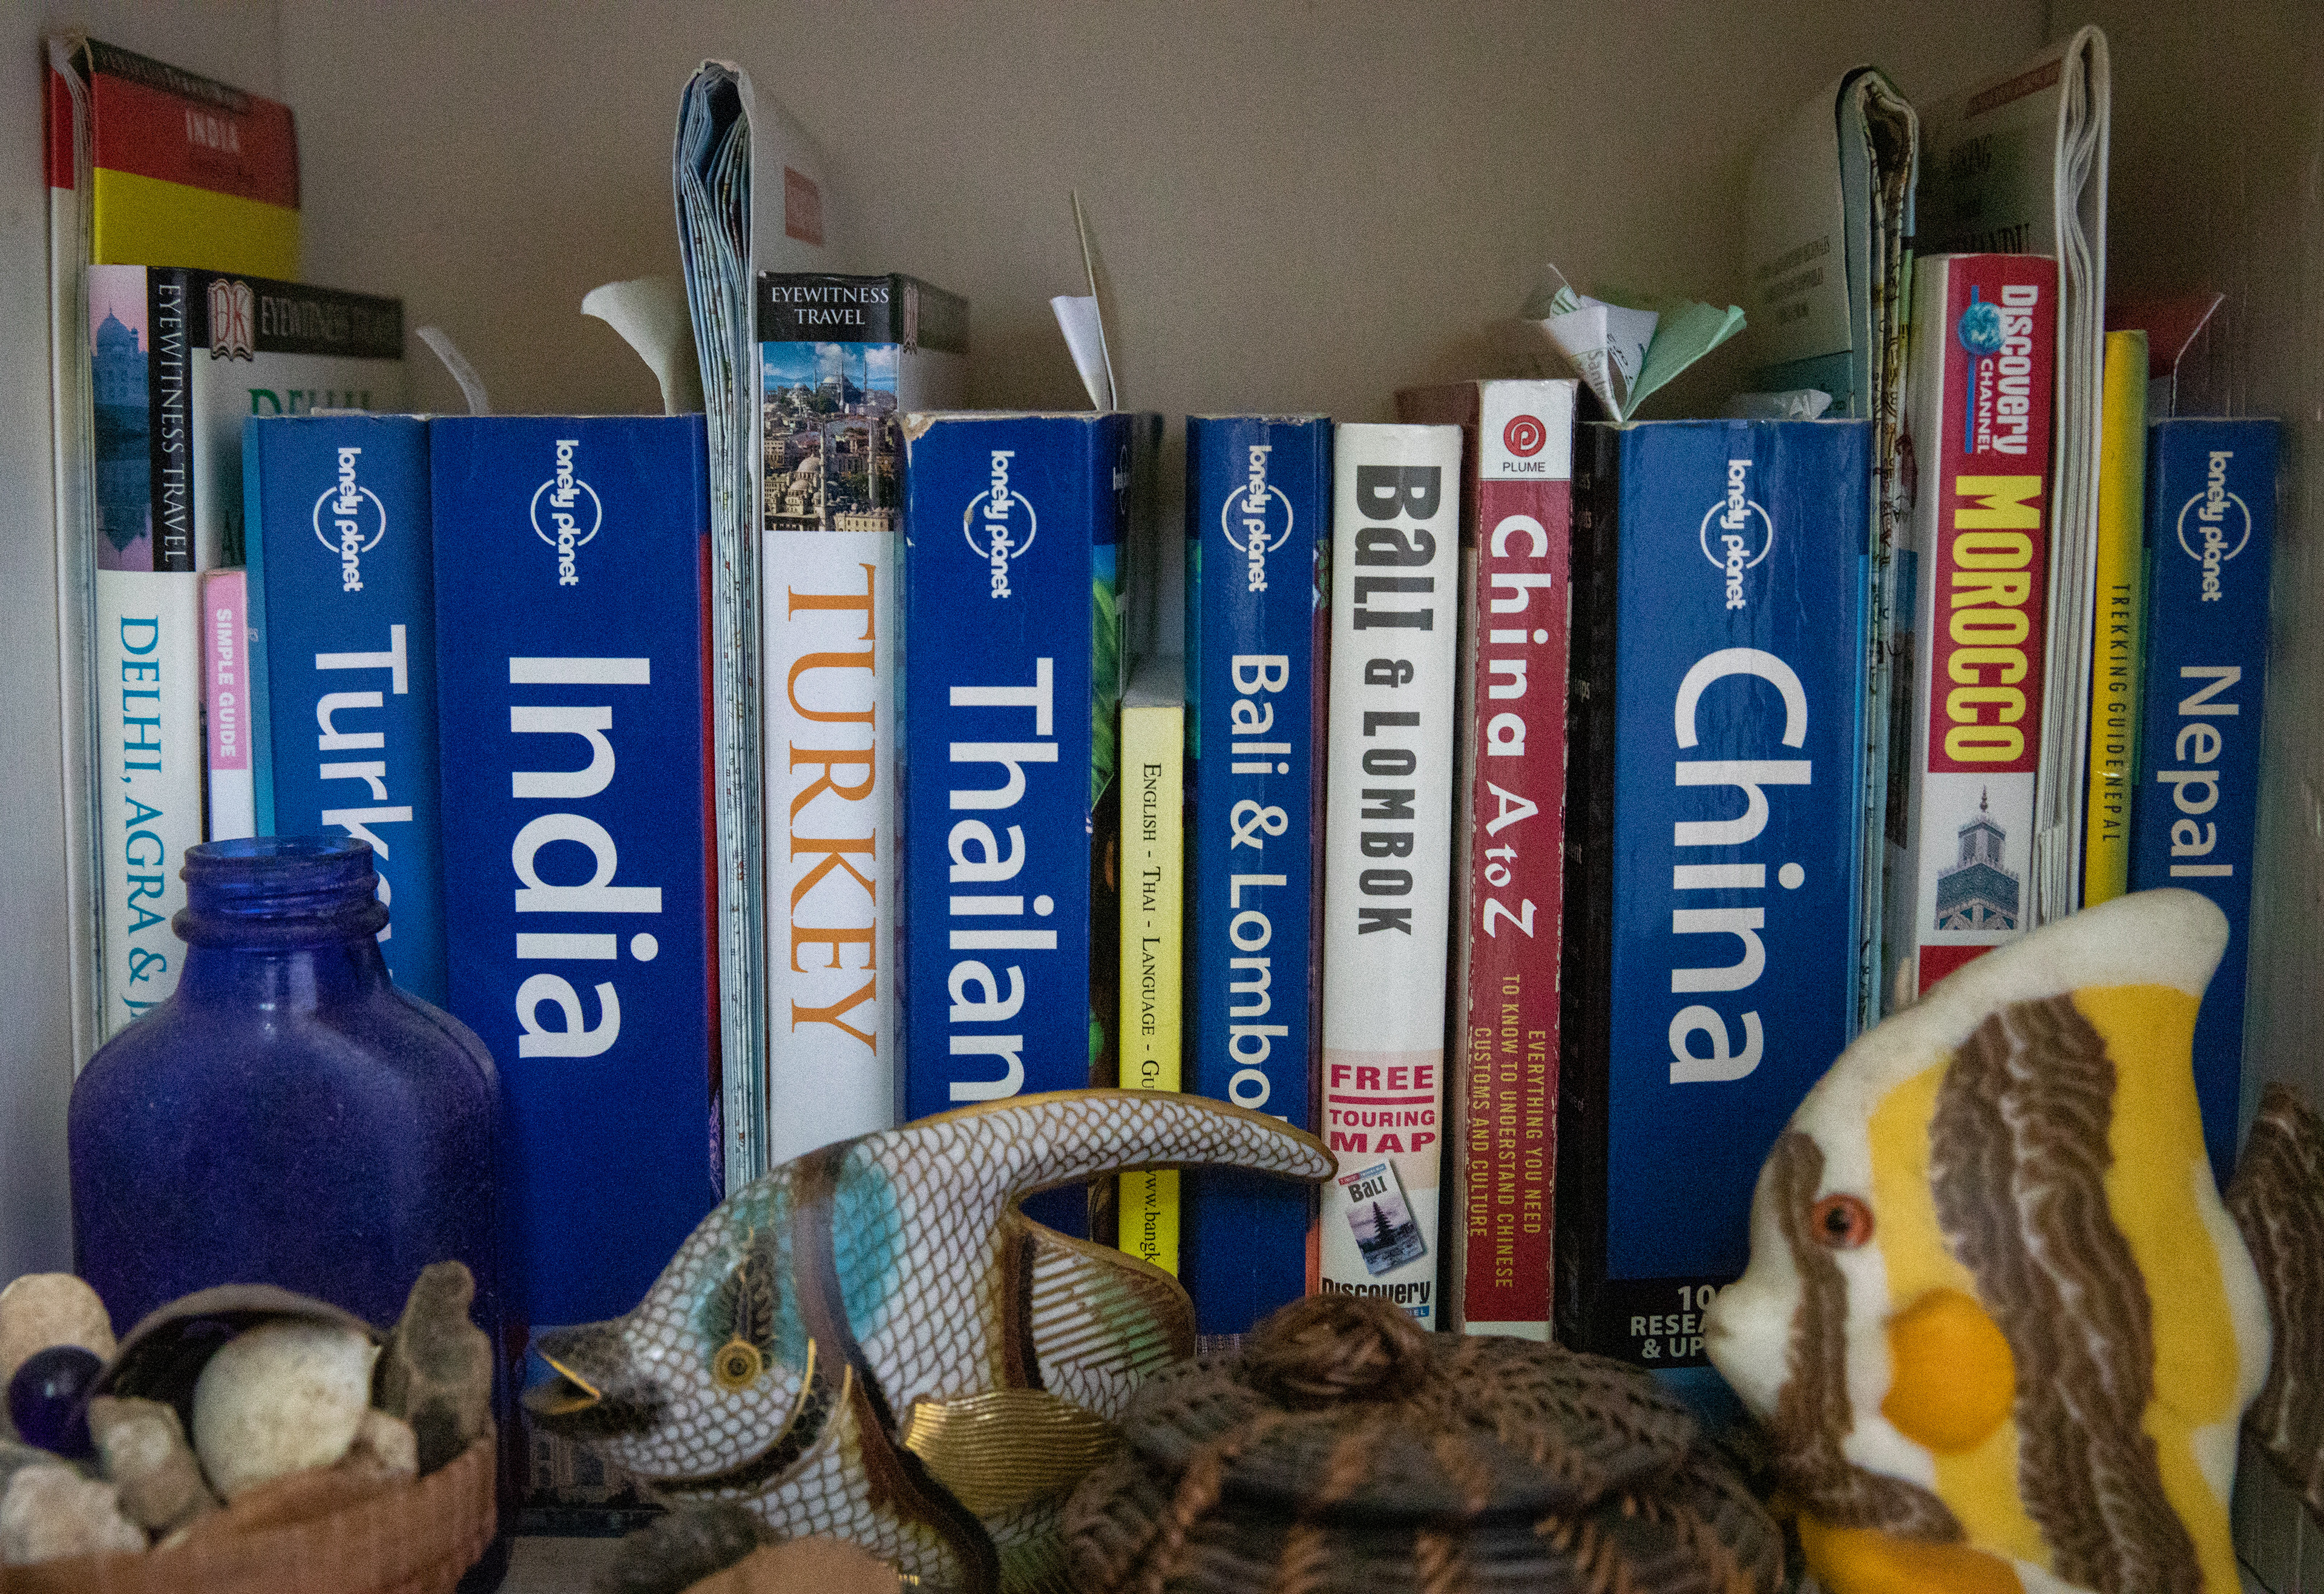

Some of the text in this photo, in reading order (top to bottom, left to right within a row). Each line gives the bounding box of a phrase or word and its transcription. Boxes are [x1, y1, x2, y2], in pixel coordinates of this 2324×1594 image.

[214, 287, 249, 344] DK
[772, 287, 890, 304] EYEWITNESS
[794, 309, 865, 325] TRAVEL
[158, 283, 187, 562] EYEWITNESS TRAVEL
[1502, 462, 1546, 473] PLUME
[1977, 358, 1994, 454] CHANNEL
[332, 447, 364, 592] lonely planet
[549, 440, 580, 586] lonely planet
[985, 450, 1015, 599] lonely planet
[1242, 445, 1272, 593] lonely planet
[1719, 459, 1753, 610] lonely planet
[2199, 451, 2233, 602] lonely planet
[216, 608, 237, 757] SIMPLE GUIDE
[1364, 658, 1415, 688] &
[1944, 475, 2042, 762] MOROCCO
[120, 615, 162, 784] DELHI,
[1483, 514, 1551, 938] China A to Z
[2103, 584, 2130, 842] TREKKING GUIDE NEPAL
[2156, 665, 2241, 877] Nepal
[124, 796, 166, 937] AGRA
[315, 624, 413, 976] Turk
[509, 657, 663, 1058] India
[787, 562, 878, 1058] TURKEY
[1357, 711, 1420, 937] LOMBOK
[1668, 647, 1812, 1085] China
[947, 657, 1059, 1102] Thailan
[1228, 654, 1292, 1124] Bali & Lombo
[128, 947, 167, 987] &
[1328, 1108, 1436, 1128] TOURING
[1328, 1131, 1436, 1154] MAP
[1330, 1064, 1434, 1091] FREE
[1470, 1027, 1492, 1238] CUSTOMS AND CULTURE
[1495, 974, 1520, 1288] TO KNOW TO UNDERSTAND CHINESE
[1524, 1030, 1546, 1234] EVERYTHING YOU NEED
[1641, 1337, 1705, 1359] & UP
[1677, 1284, 1716, 1311] 10
